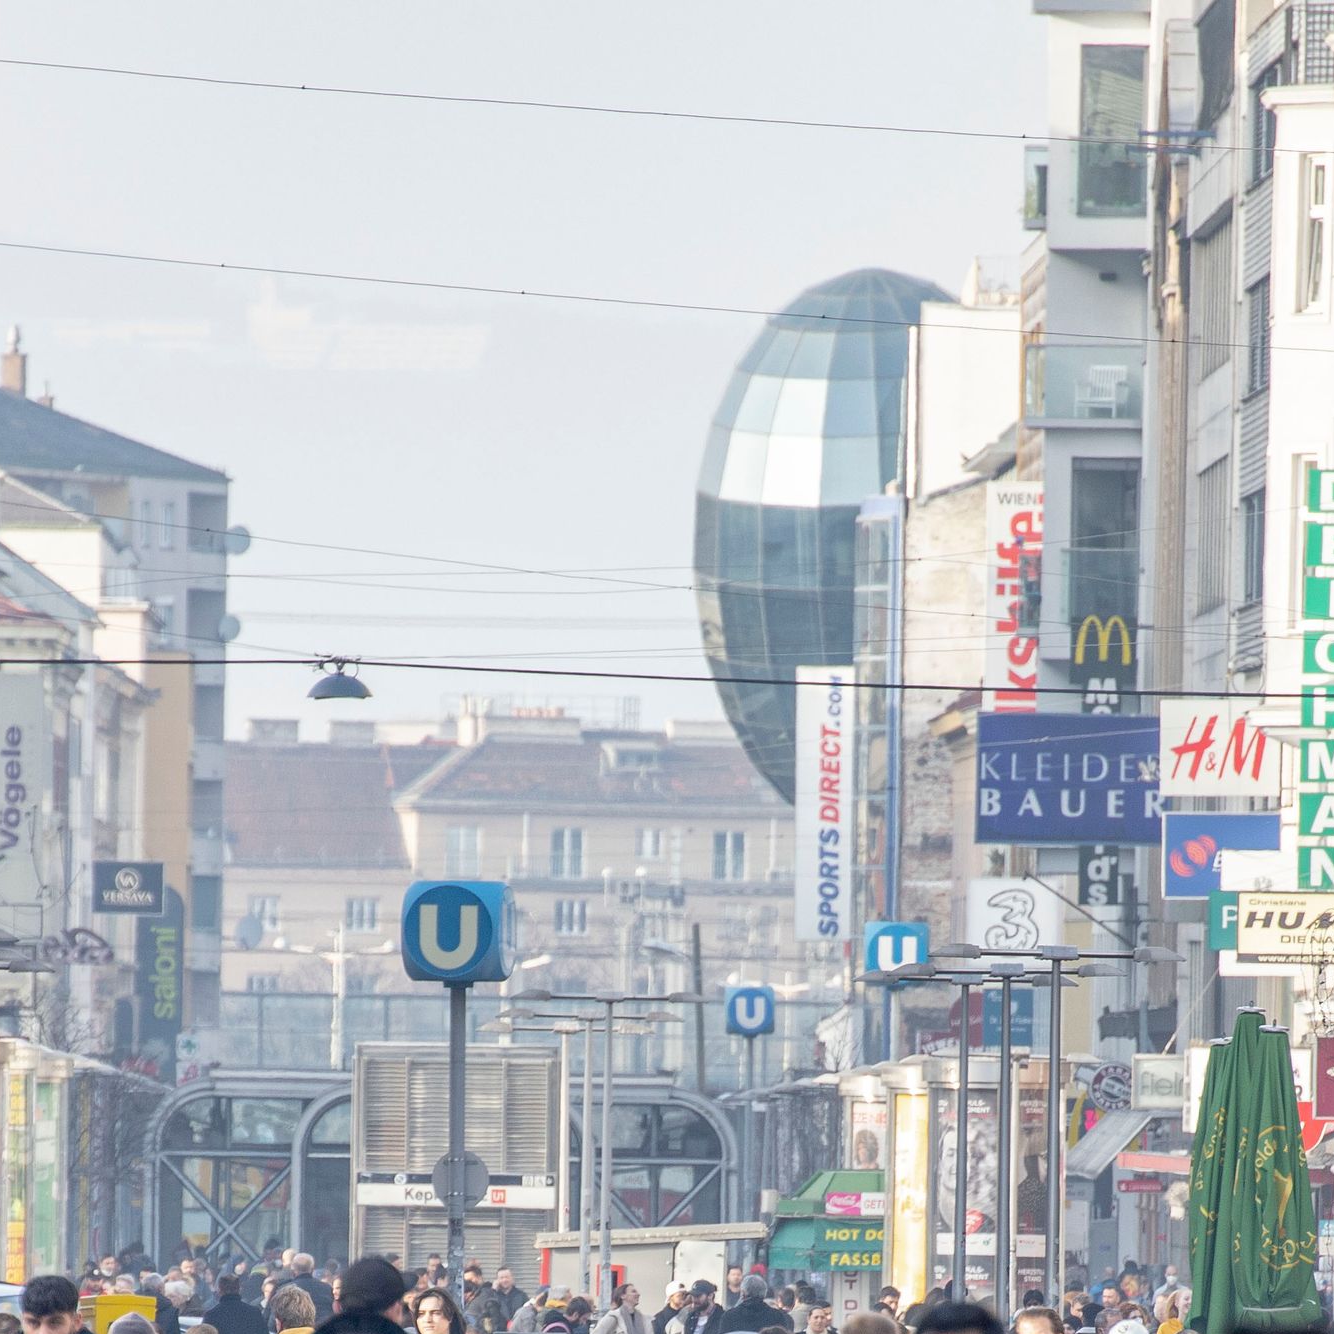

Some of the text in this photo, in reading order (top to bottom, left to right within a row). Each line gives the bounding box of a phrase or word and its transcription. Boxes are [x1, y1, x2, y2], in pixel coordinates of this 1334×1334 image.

[997, 492, 1037, 505] WIEN
[1169, 715, 1267, 782] H&M
[979, 788, 1167, 819] BAUER
[818, 829, 840, 936] SPORTS
[419, 904, 480, 971] U
[876, 935, 919, 971] U
[1280, 935, 1308, 944] DIE
[148, 926, 178, 1020] saloni
[734, 996, 768, 1029] U
[825, 1229, 861, 1242] HOT
